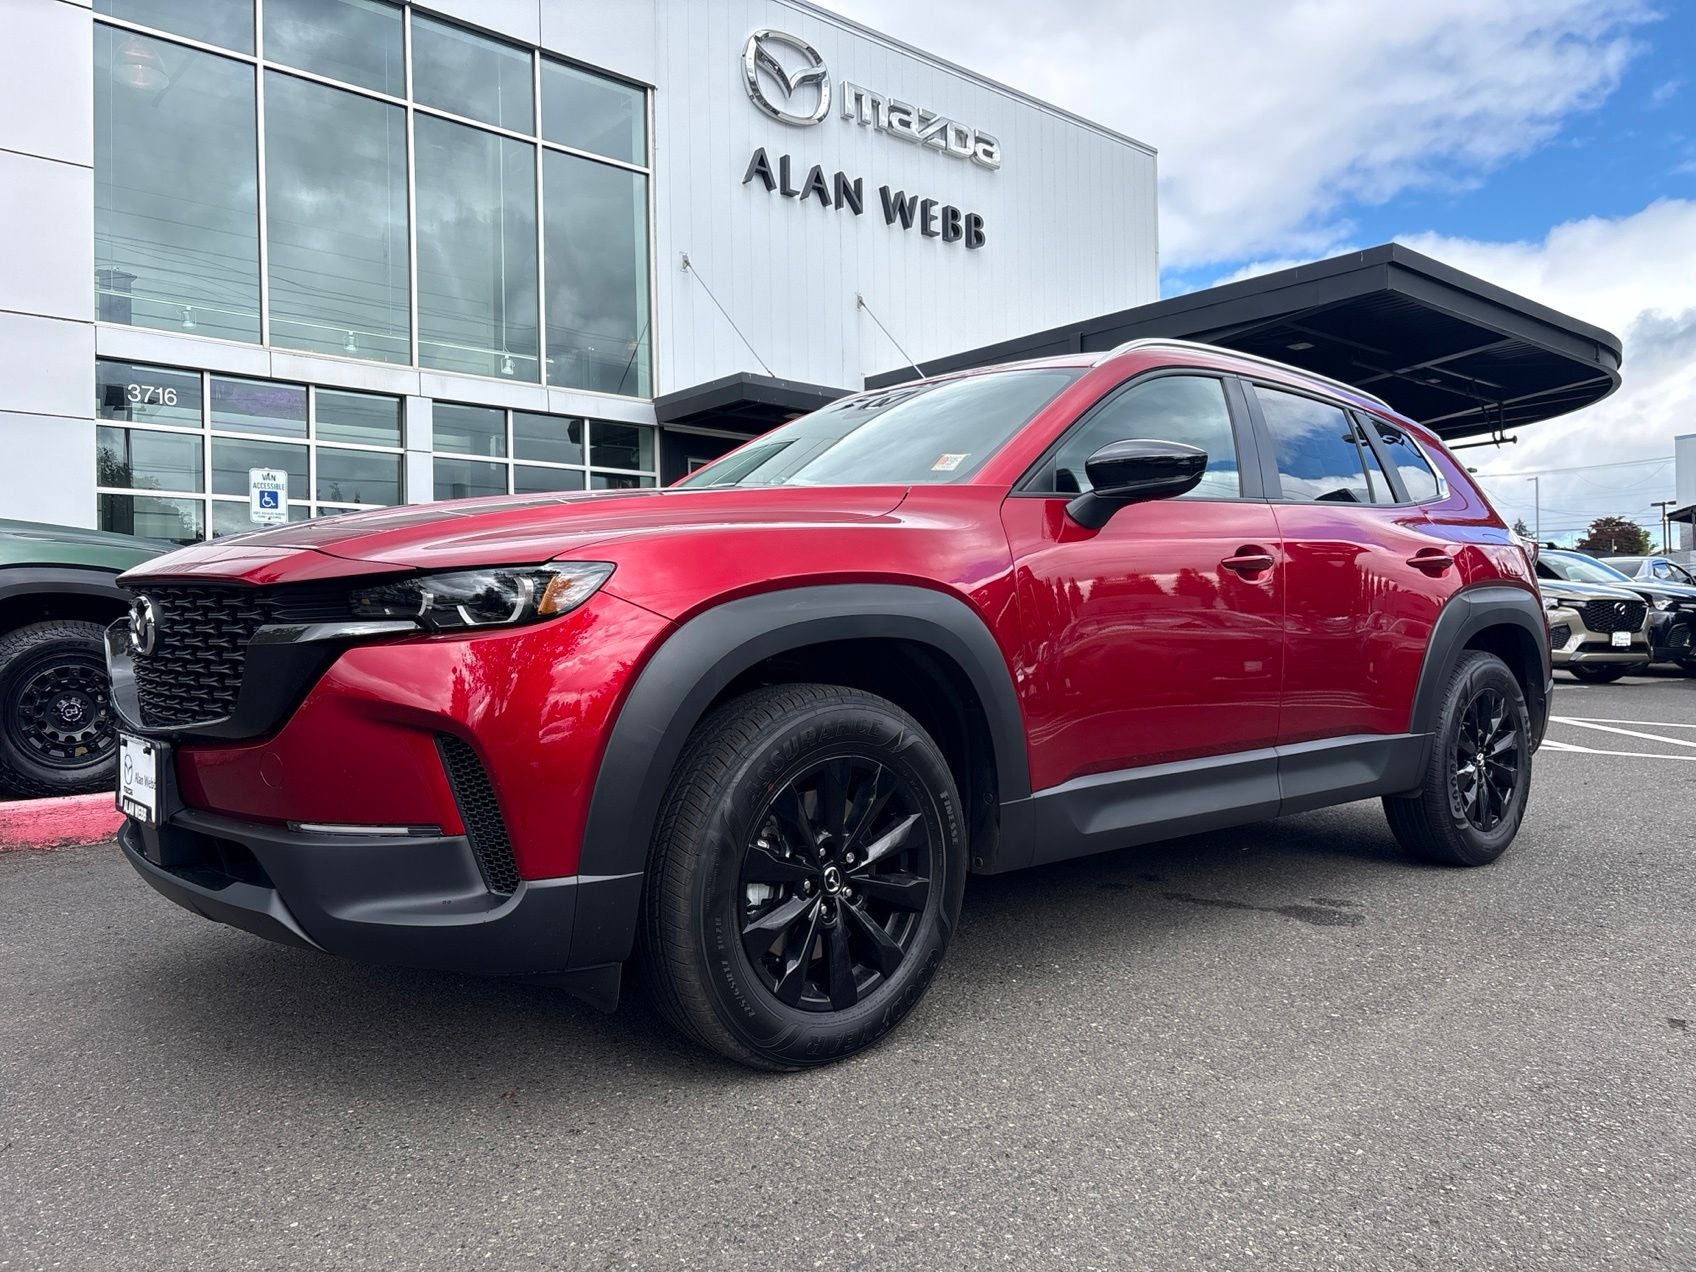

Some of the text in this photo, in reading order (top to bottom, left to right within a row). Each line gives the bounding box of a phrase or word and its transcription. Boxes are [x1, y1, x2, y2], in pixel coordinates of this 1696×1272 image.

[742, 147, 986, 249] ALAN WEBB
[128, 384, 177, 405] 3716
[261, 473, 276, 481] VAN
[253, 482, 285, 491] ACCESSIBLE
[135, 771, 144, 786] Alan
